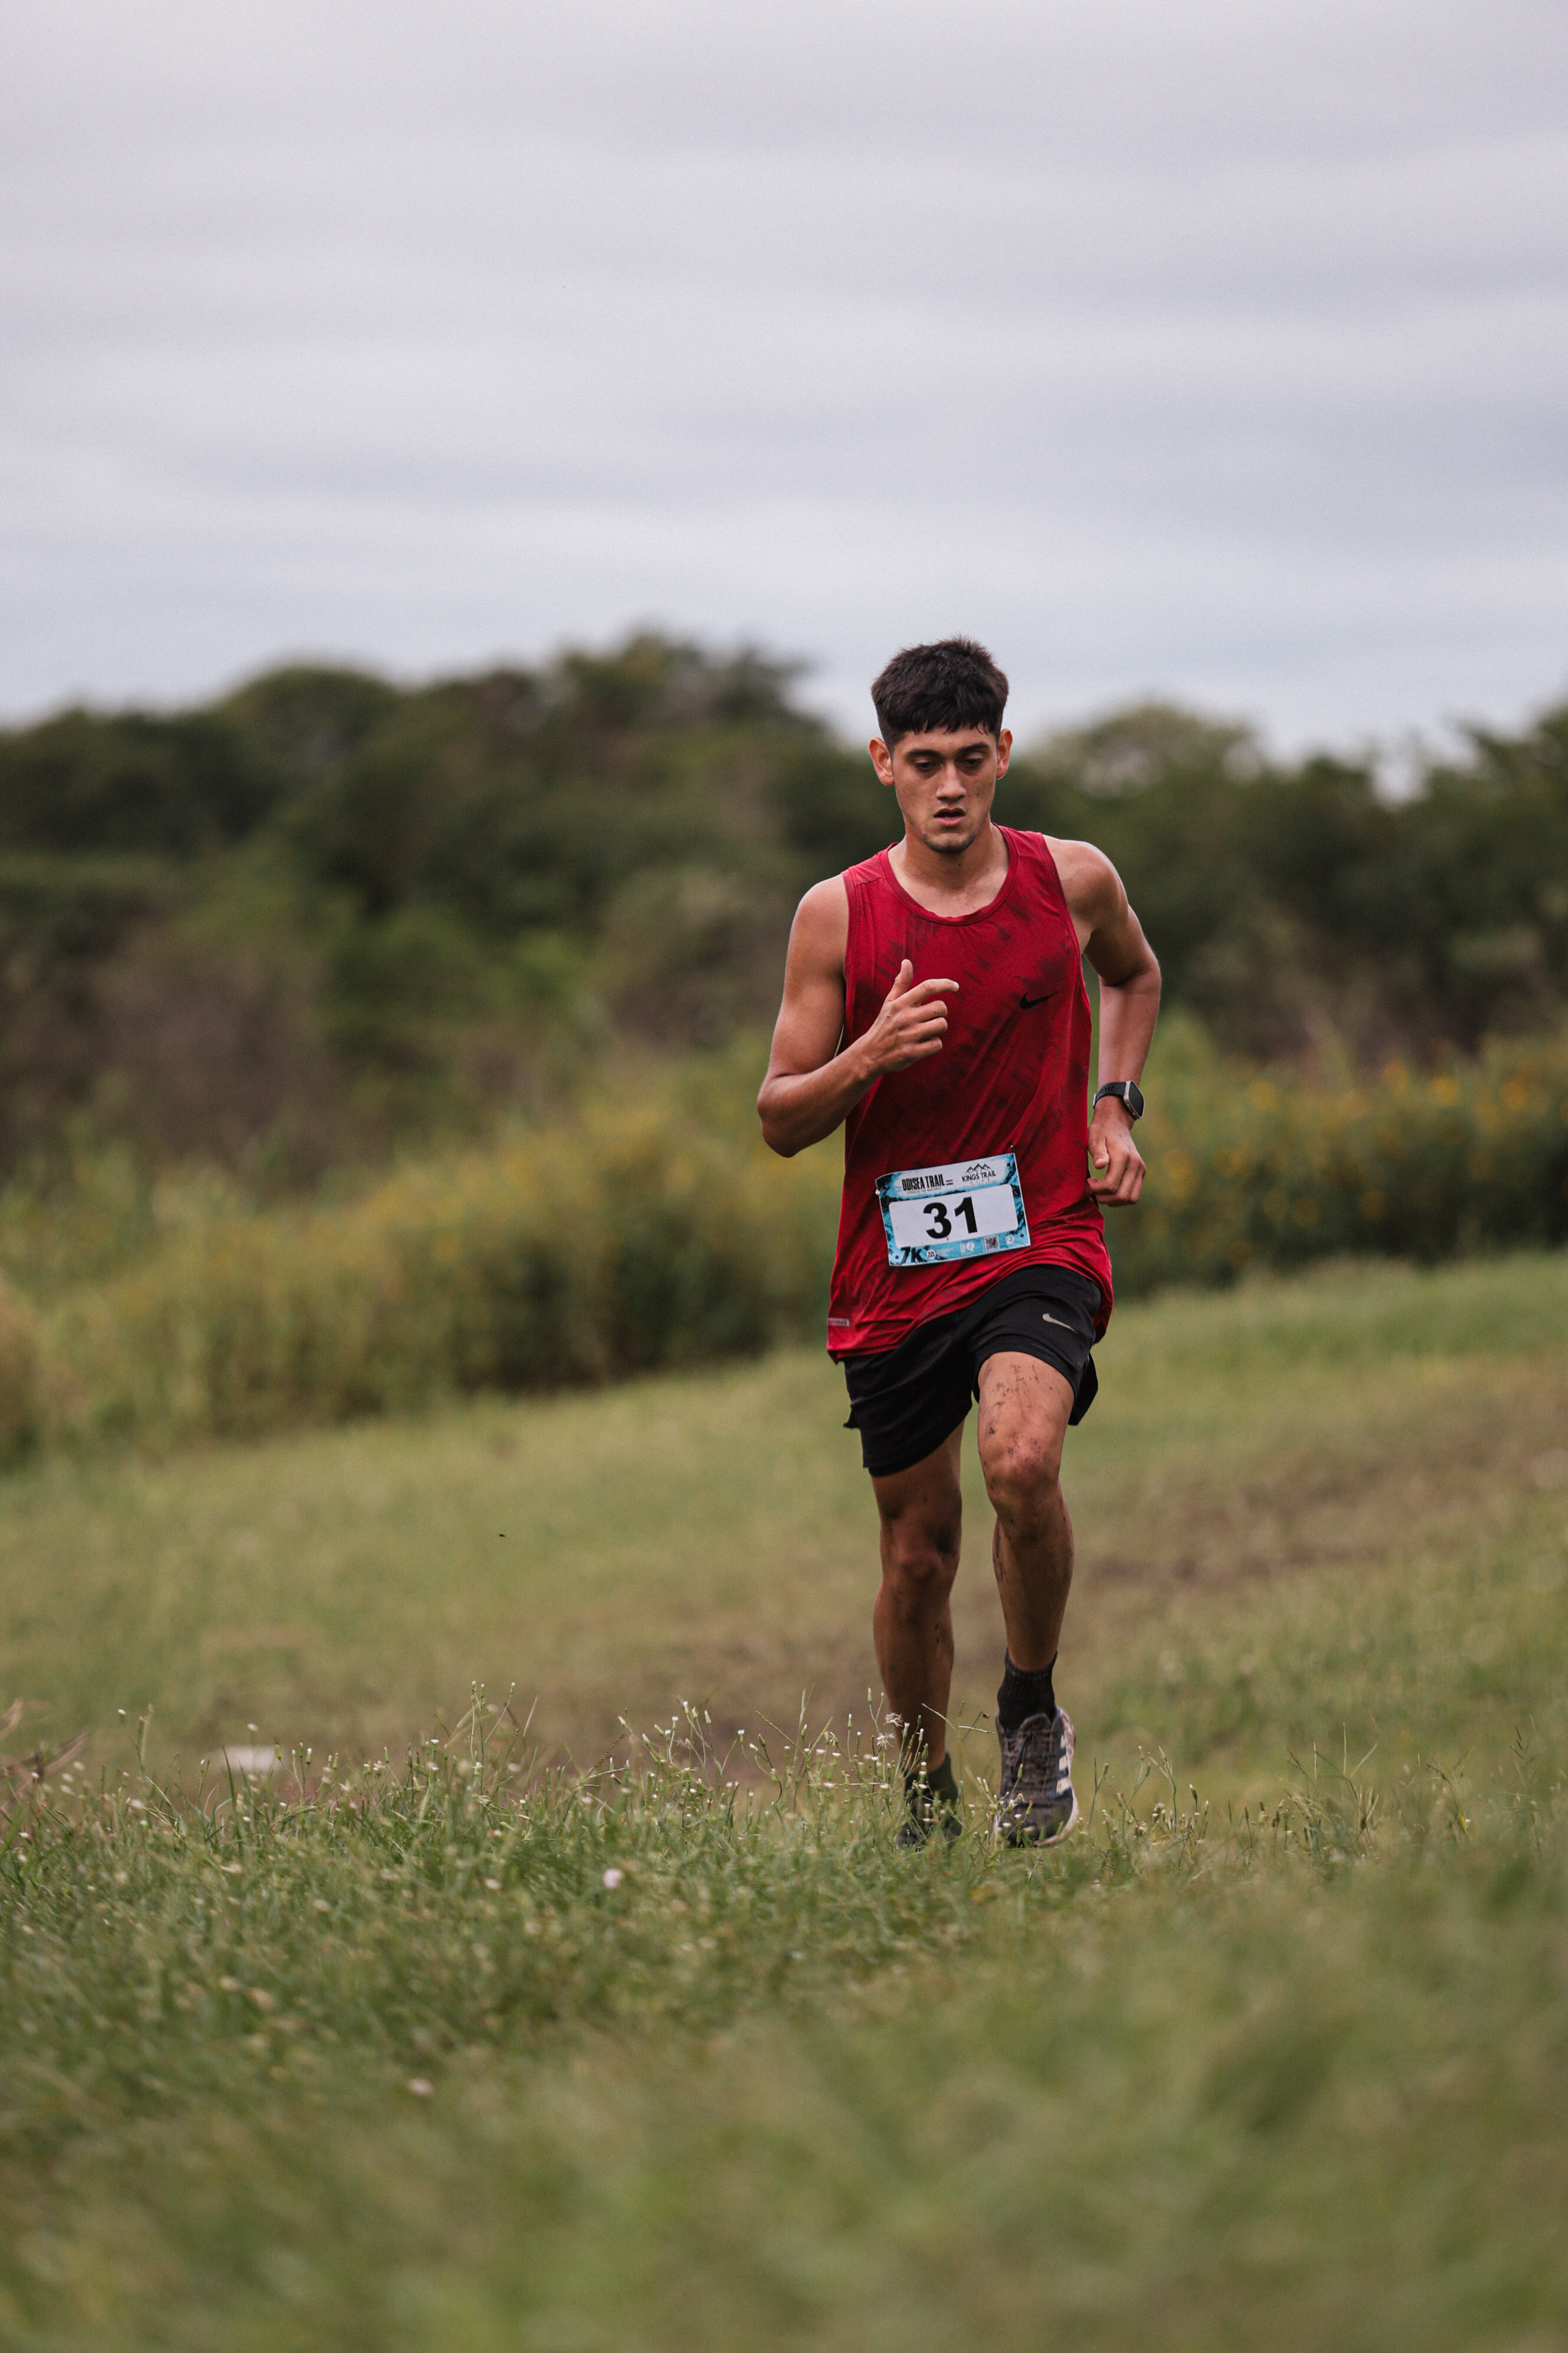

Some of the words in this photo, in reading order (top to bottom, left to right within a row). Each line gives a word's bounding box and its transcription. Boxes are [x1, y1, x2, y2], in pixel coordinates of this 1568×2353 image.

[901, 1176, 925, 1191] ODISEA
[925, 1174, 945, 1188] TRAIL
[962, 1172, 979, 1182] KINGS
[981, 1170, 996, 1179] TRAIL
[923, 1196, 978, 1238] 31
[900, 1246, 923, 1264] 7K
